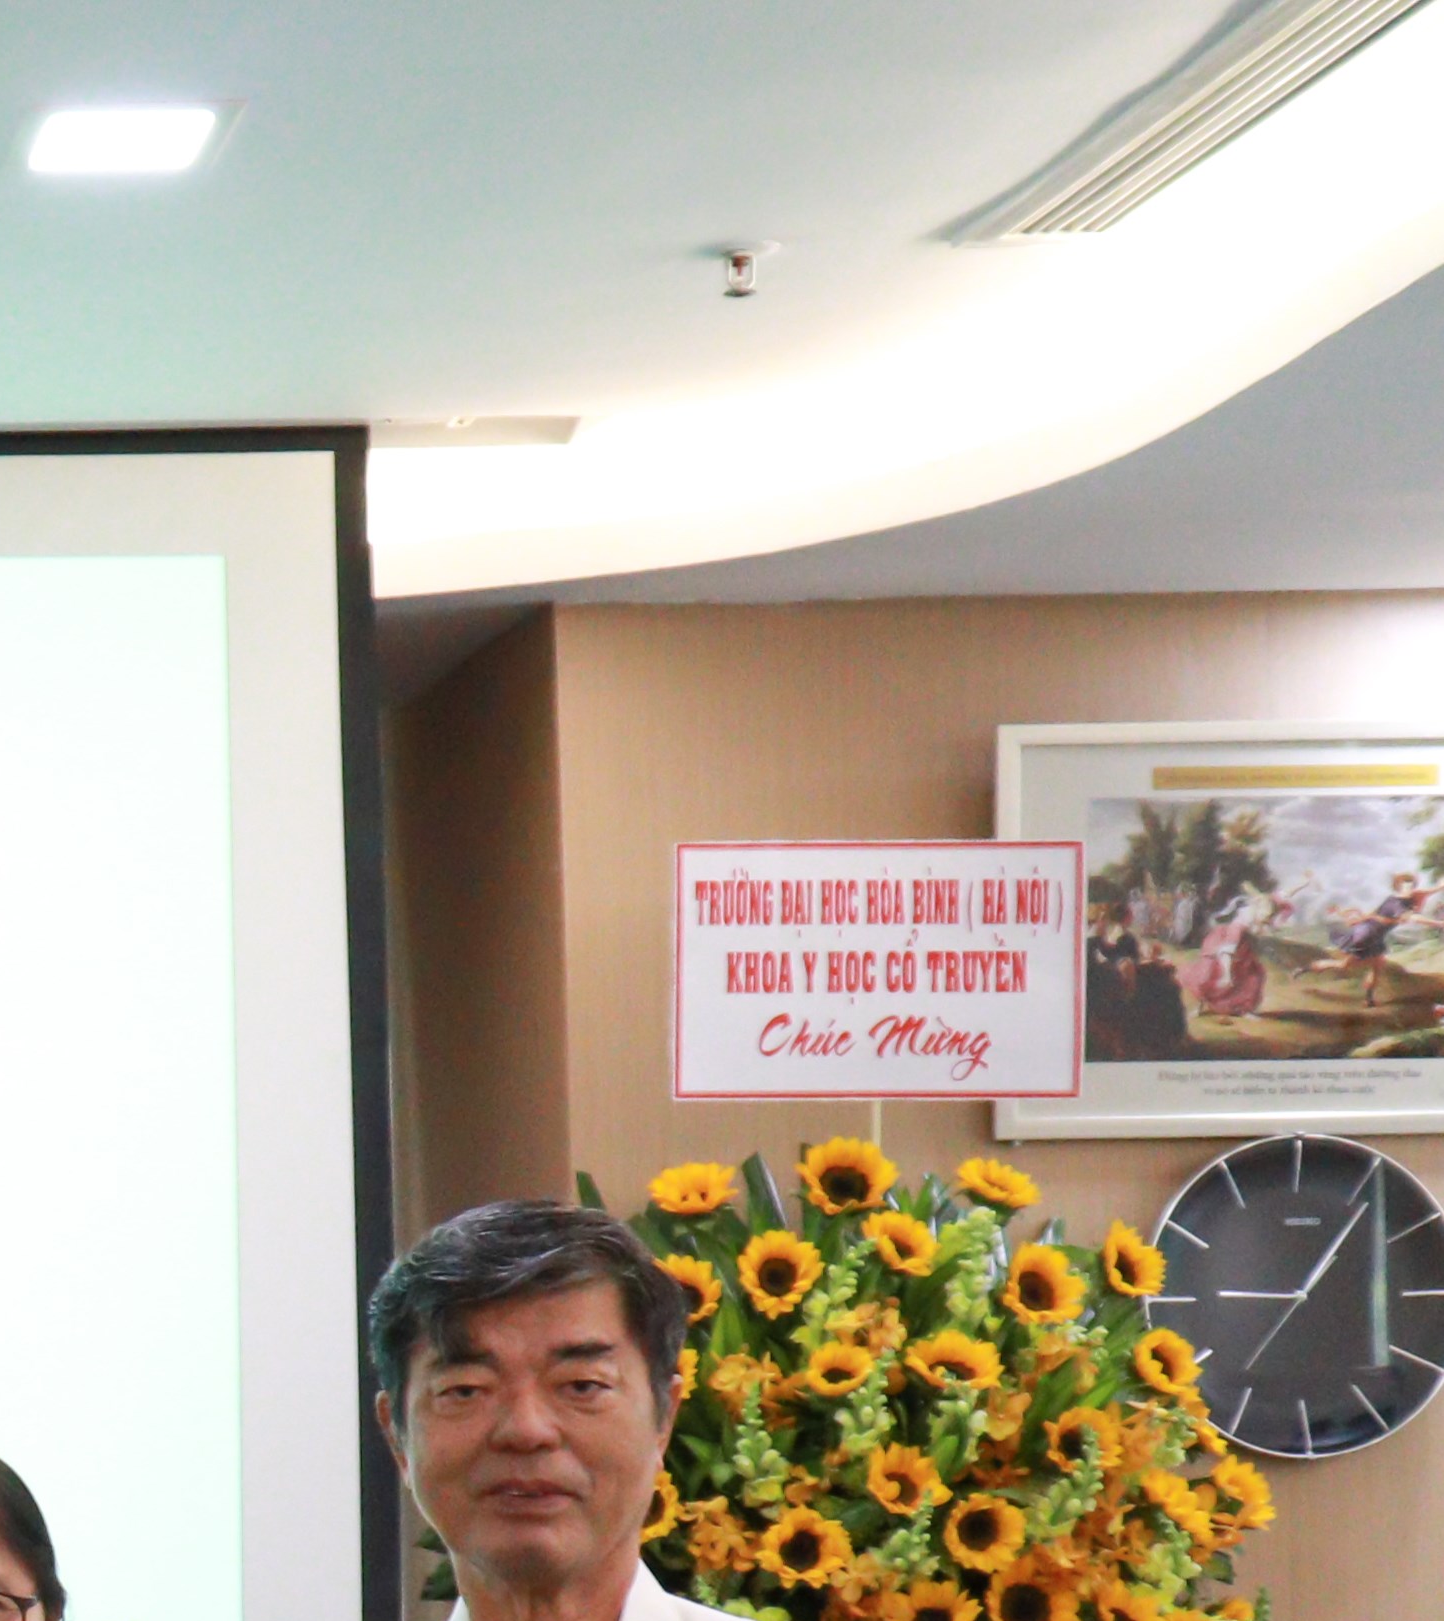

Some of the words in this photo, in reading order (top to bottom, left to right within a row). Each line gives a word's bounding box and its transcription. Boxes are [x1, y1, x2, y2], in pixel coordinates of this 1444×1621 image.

[695, 867, 774, 926] TRƯỜNG
[820, 879, 859, 938] HỌC
[867, 867, 904, 926] HÒA
[913, 867, 961, 926] BÌNH
[982, 867, 1008, 926] HÀ
[1016, 867, 1051, 937] NỘI
[726, 950, 794, 994] KHOA
[802, 950, 819, 993] Y
[827, 950, 877, 1005] HỌC
[886, 929, 918, 994] CỔ
[927, 932, 1028, 994] TRUYỀN
[758, 1013, 856, 1058] Chúc
[869, 1015, 992, 1081] Mừng
